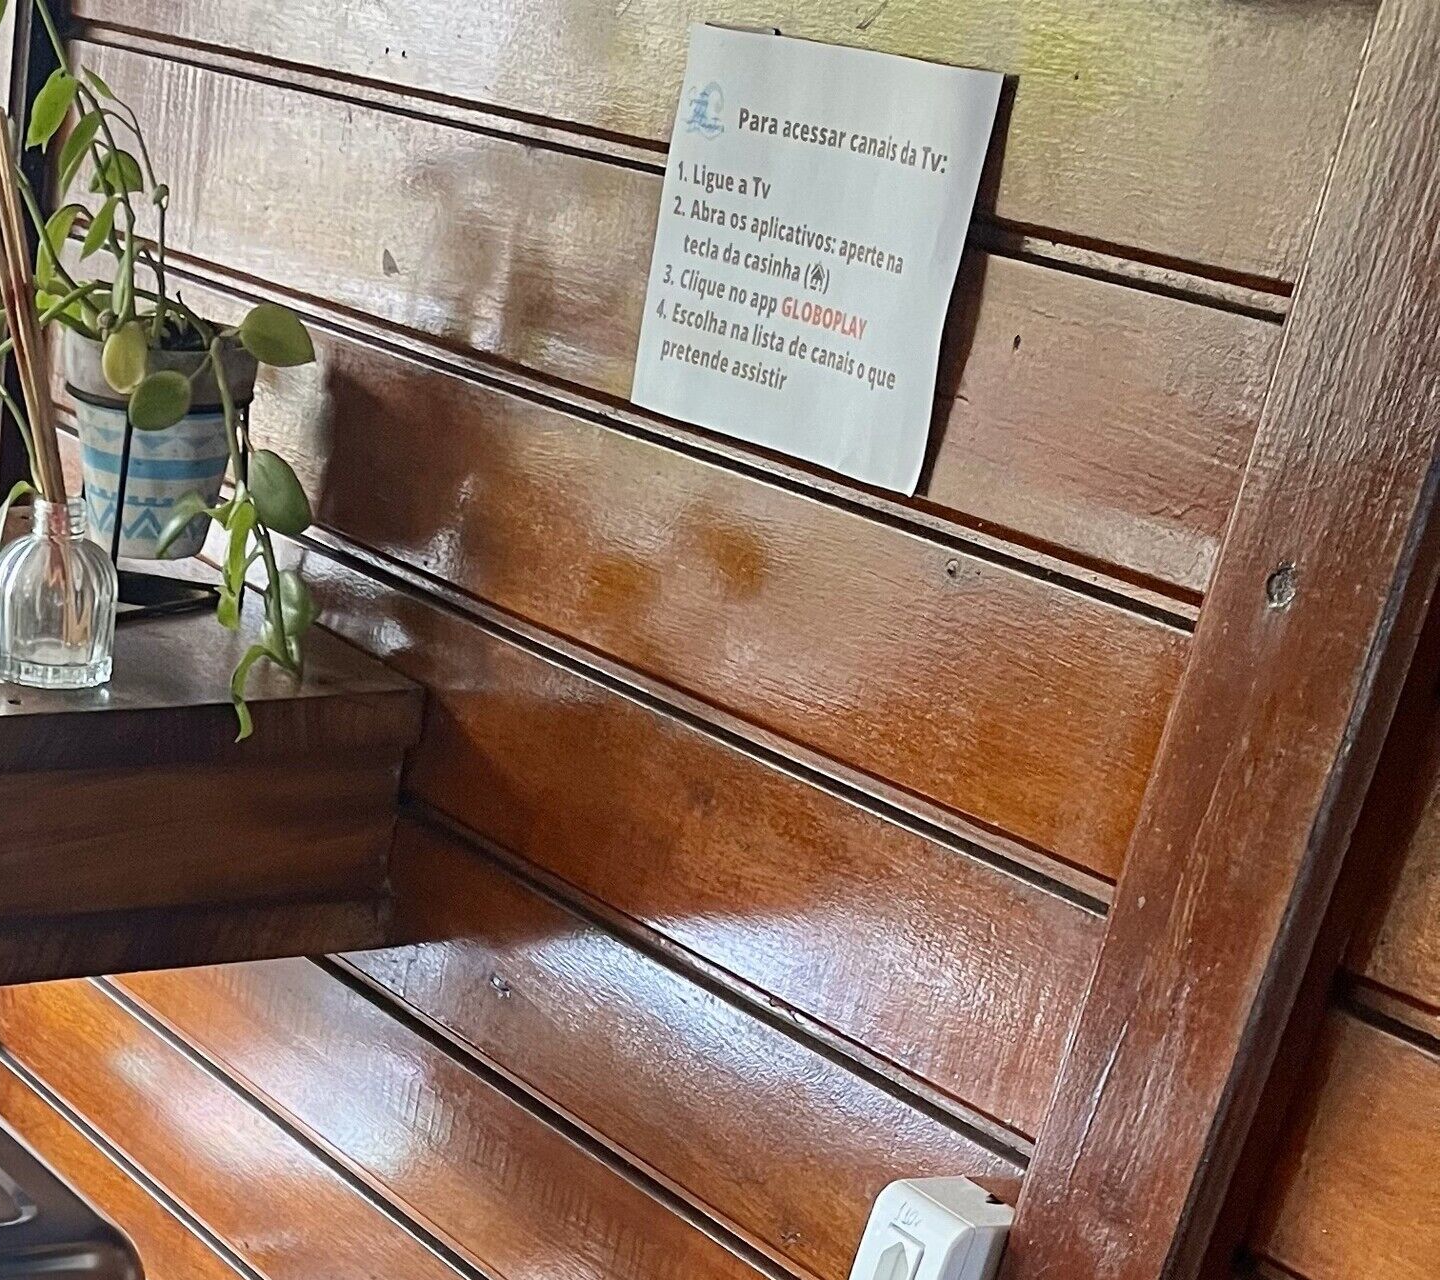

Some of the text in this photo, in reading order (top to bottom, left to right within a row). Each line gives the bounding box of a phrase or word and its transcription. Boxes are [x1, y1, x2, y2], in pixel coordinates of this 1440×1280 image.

[738, 107, 948, 174] Para acessar canais da Tv:
[678, 160, 771, 200] 1. Ligue a Tv
[673, 196, 904, 274] 2. Abra os aplicativos: aperte na
[683, 234, 718, 260] tecla
[722, 242, 741, 266] da
[744, 253, 801, 282] casinha
[663, 264, 868, 340] 3. Clique no app GLOBOPLAY
[656, 299, 896, 391] 4. Escolha na lista de canais o que
[660, 340, 788, 390] pretende assistir
